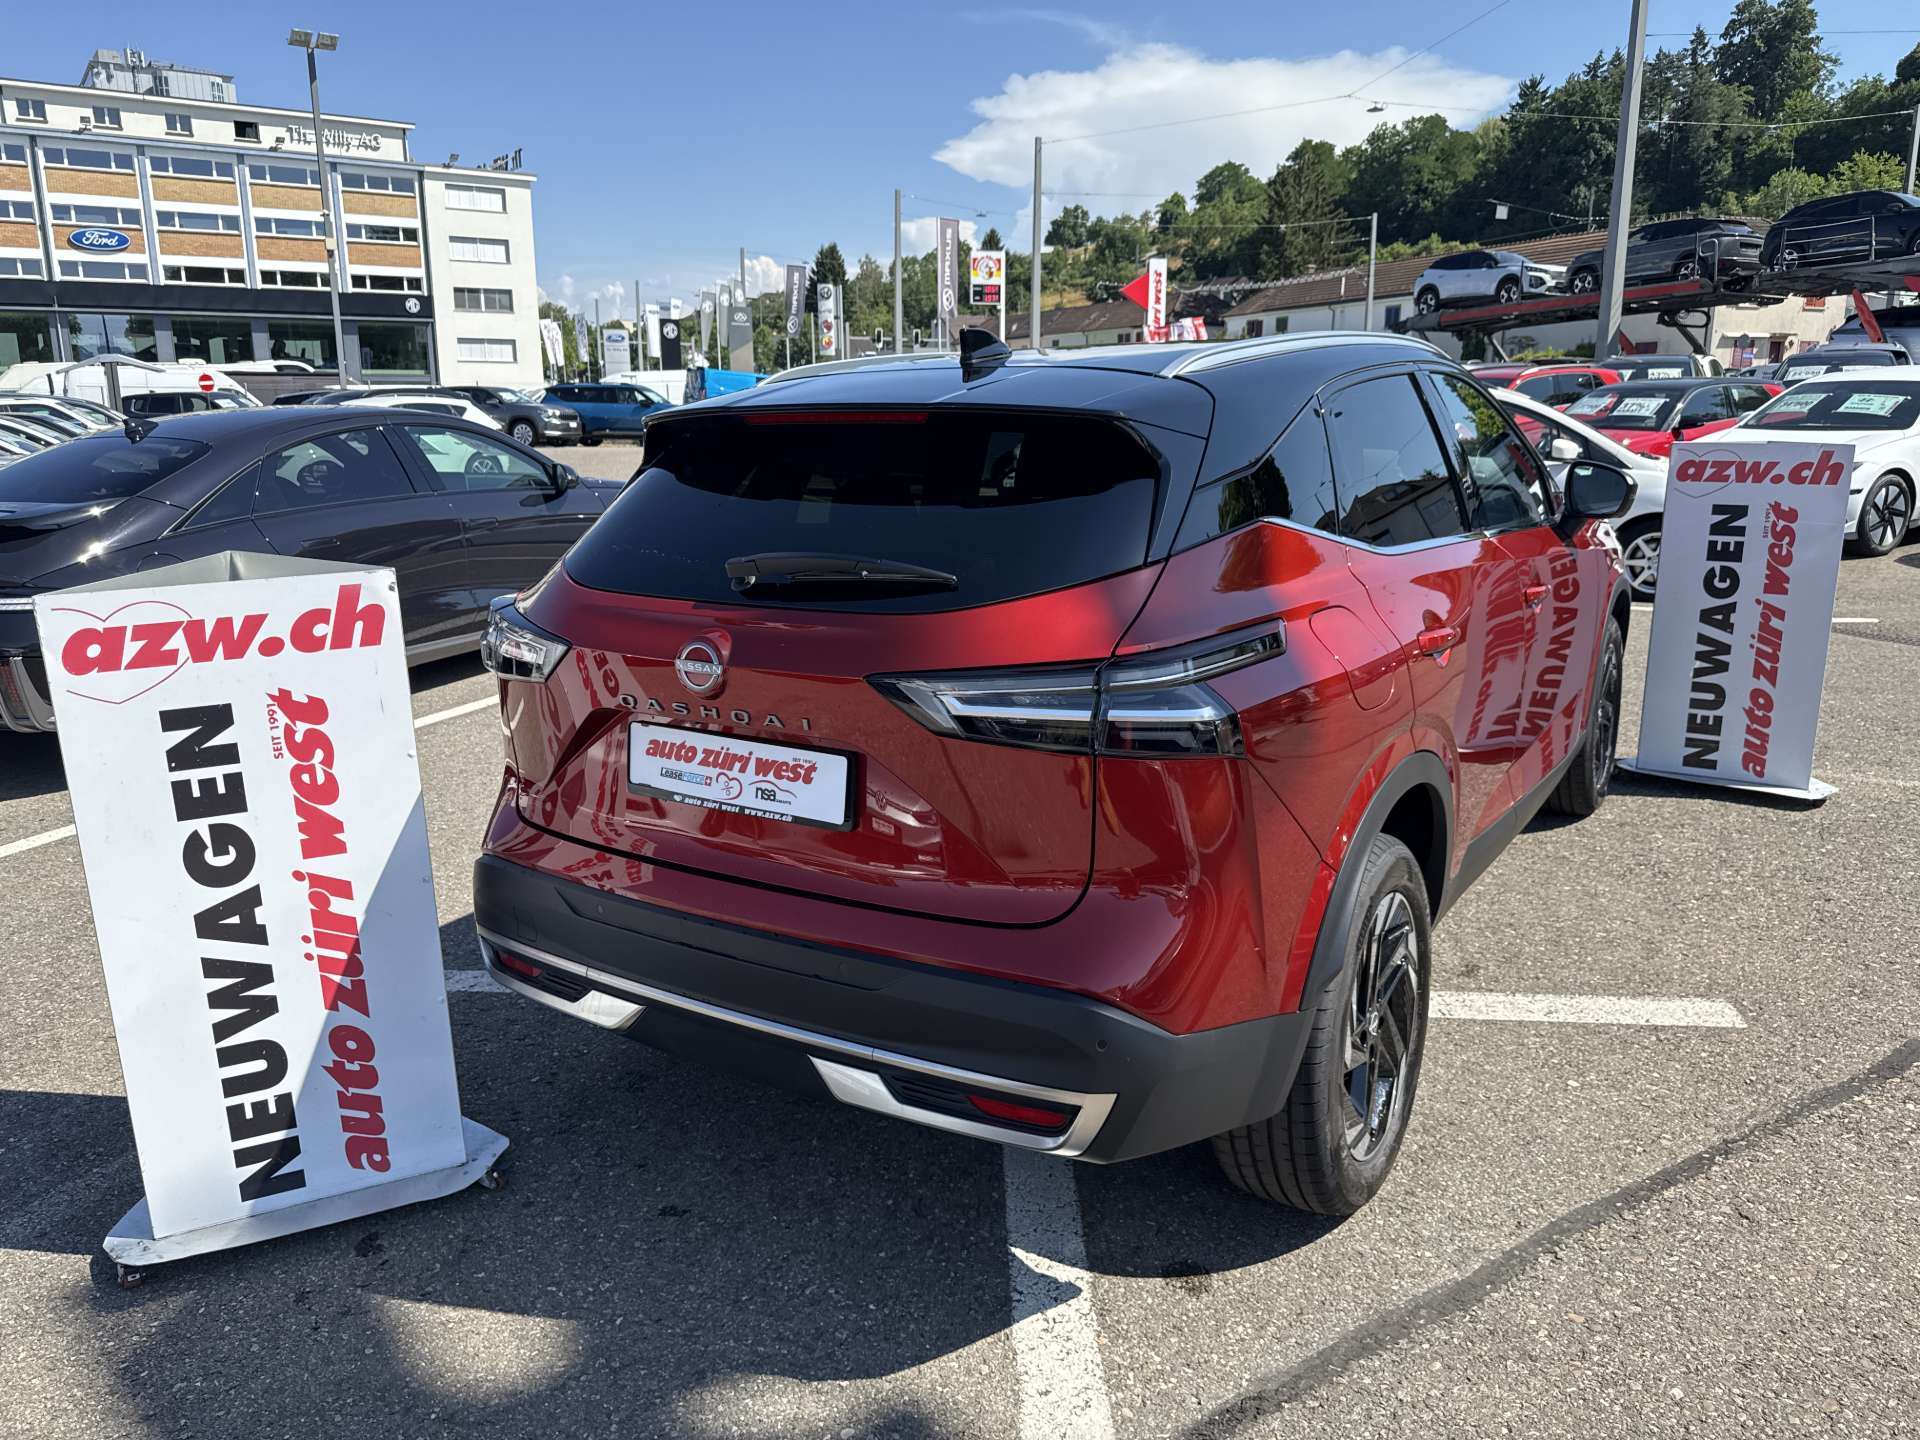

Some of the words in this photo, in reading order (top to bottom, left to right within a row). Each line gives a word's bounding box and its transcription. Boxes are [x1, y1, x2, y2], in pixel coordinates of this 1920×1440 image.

[1676, 450, 1844, 486] azw.ch
[1763, 500, 1799, 596] west
[62, 584, 385, 676] azw.ch
[677, 660, 721, 675] NISSAN
[1682, 503, 1749, 770] NEUWAGEN
[1749, 598, 1784, 689] züri
[266, 703, 280, 731] 1991
[272, 735, 285, 760] SEIT
[618, 693, 811, 731] QASHQAI
[1741, 687, 1774, 779] auto
[265, 687, 348, 860] west
[645, 739, 697, 763] auto
[697, 746, 753, 773] züri
[755, 756, 817, 785] west
[755, 787, 776, 801] nsa
[159, 703, 306, 1203] NEUWAGEN
[293, 870, 371, 1019] züri
[321, 1028, 392, 1174] auto
